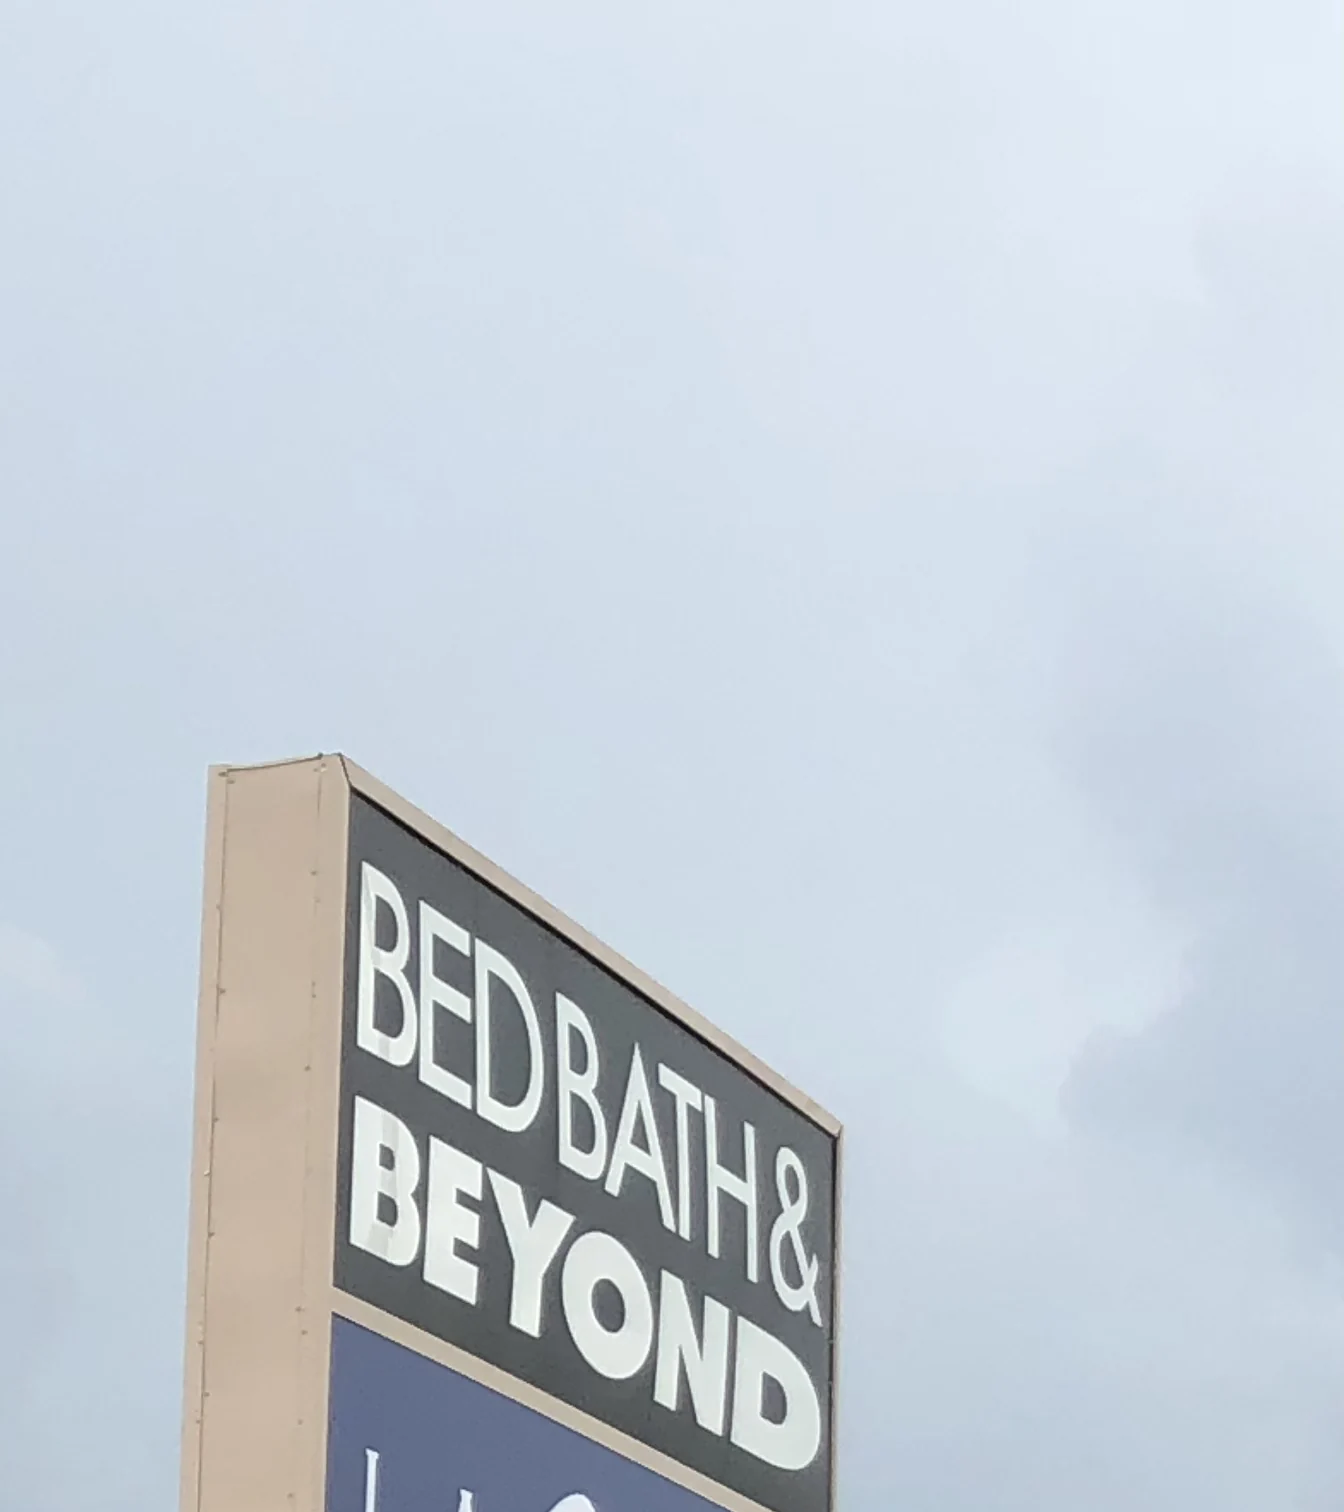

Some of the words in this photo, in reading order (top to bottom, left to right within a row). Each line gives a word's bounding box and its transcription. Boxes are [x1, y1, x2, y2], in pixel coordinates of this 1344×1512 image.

[349, 1093, 822, 1472] BEYOND
[355, 860, 544, 1133] BED
[556, 992, 759, 1282] BATH
[768, 1145, 824, 1328] &
